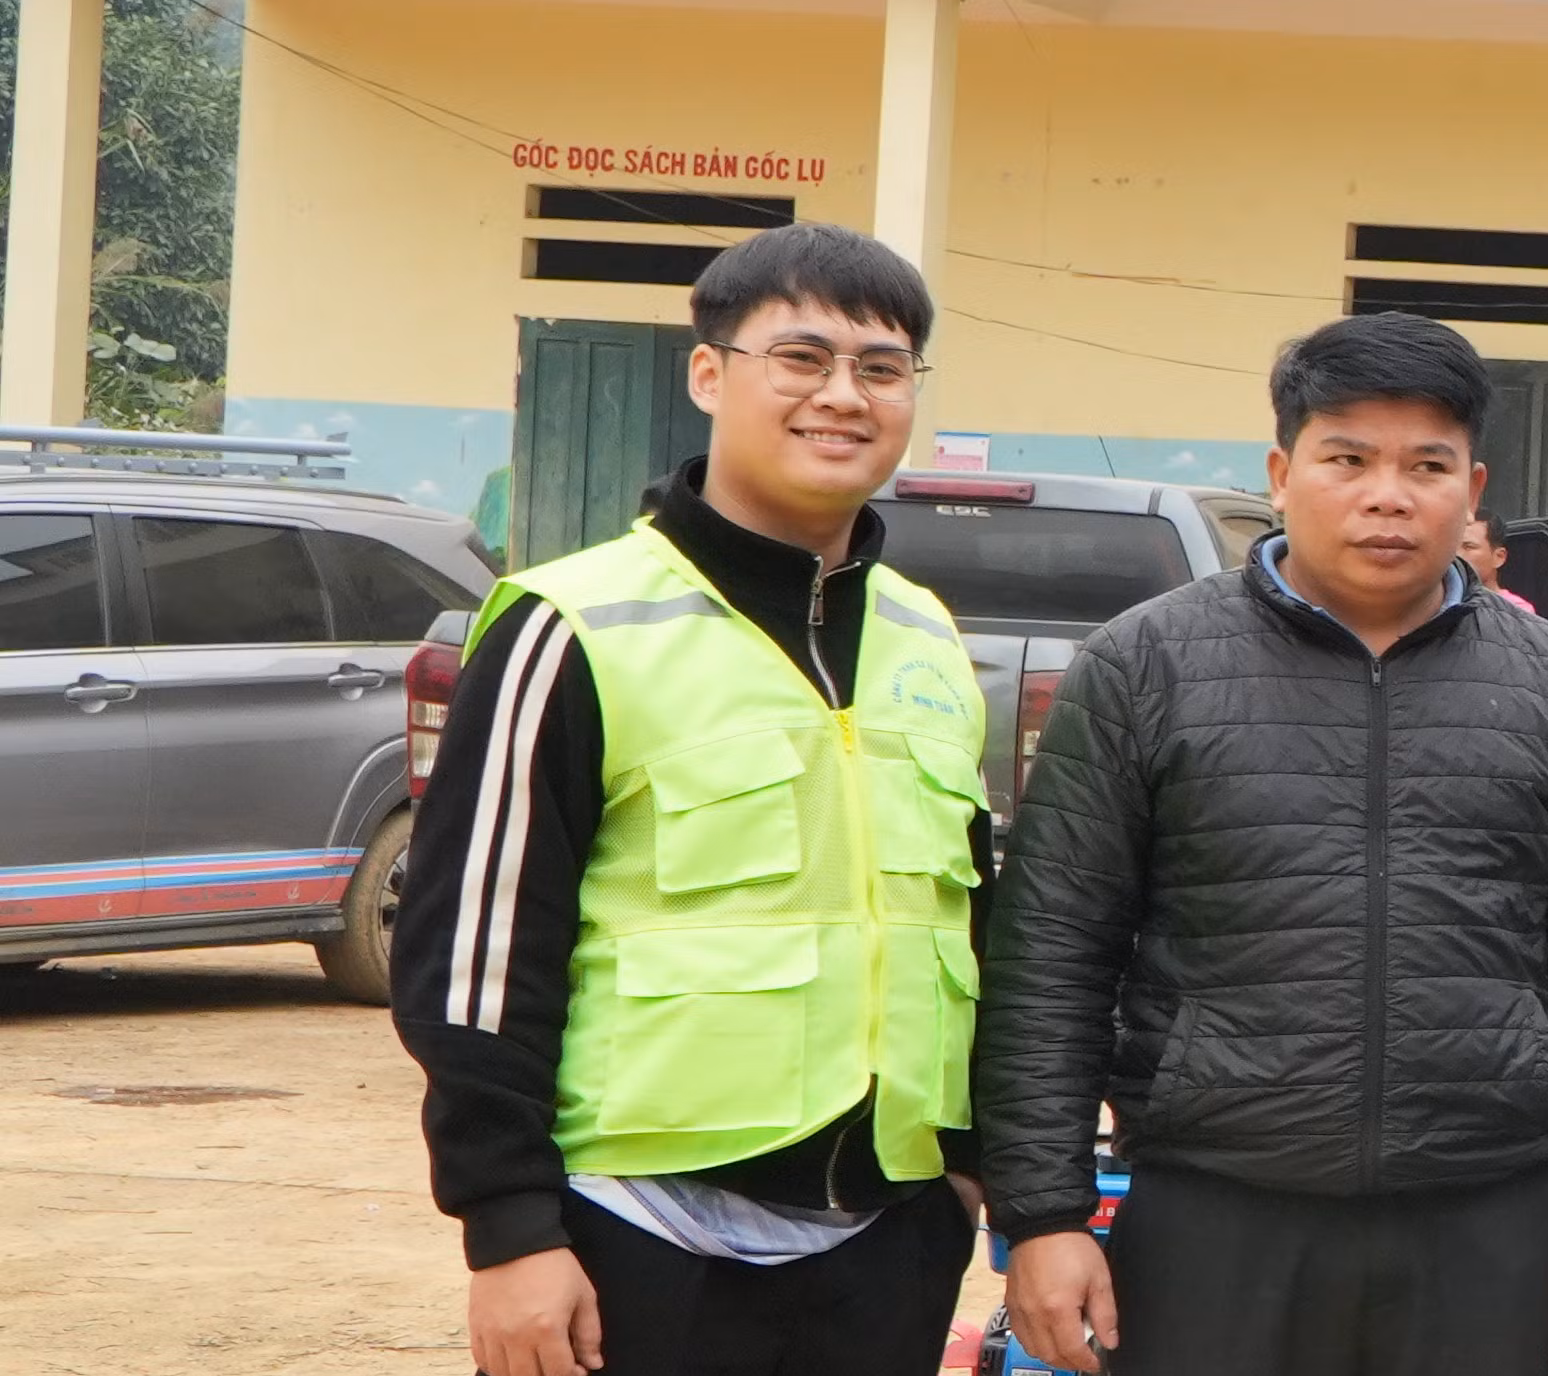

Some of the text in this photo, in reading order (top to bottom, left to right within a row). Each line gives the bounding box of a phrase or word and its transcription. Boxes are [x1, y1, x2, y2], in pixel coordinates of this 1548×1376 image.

[513, 138, 825, 187] GÓC ĐỌC SÁCH BẢN GỐC LỤ
